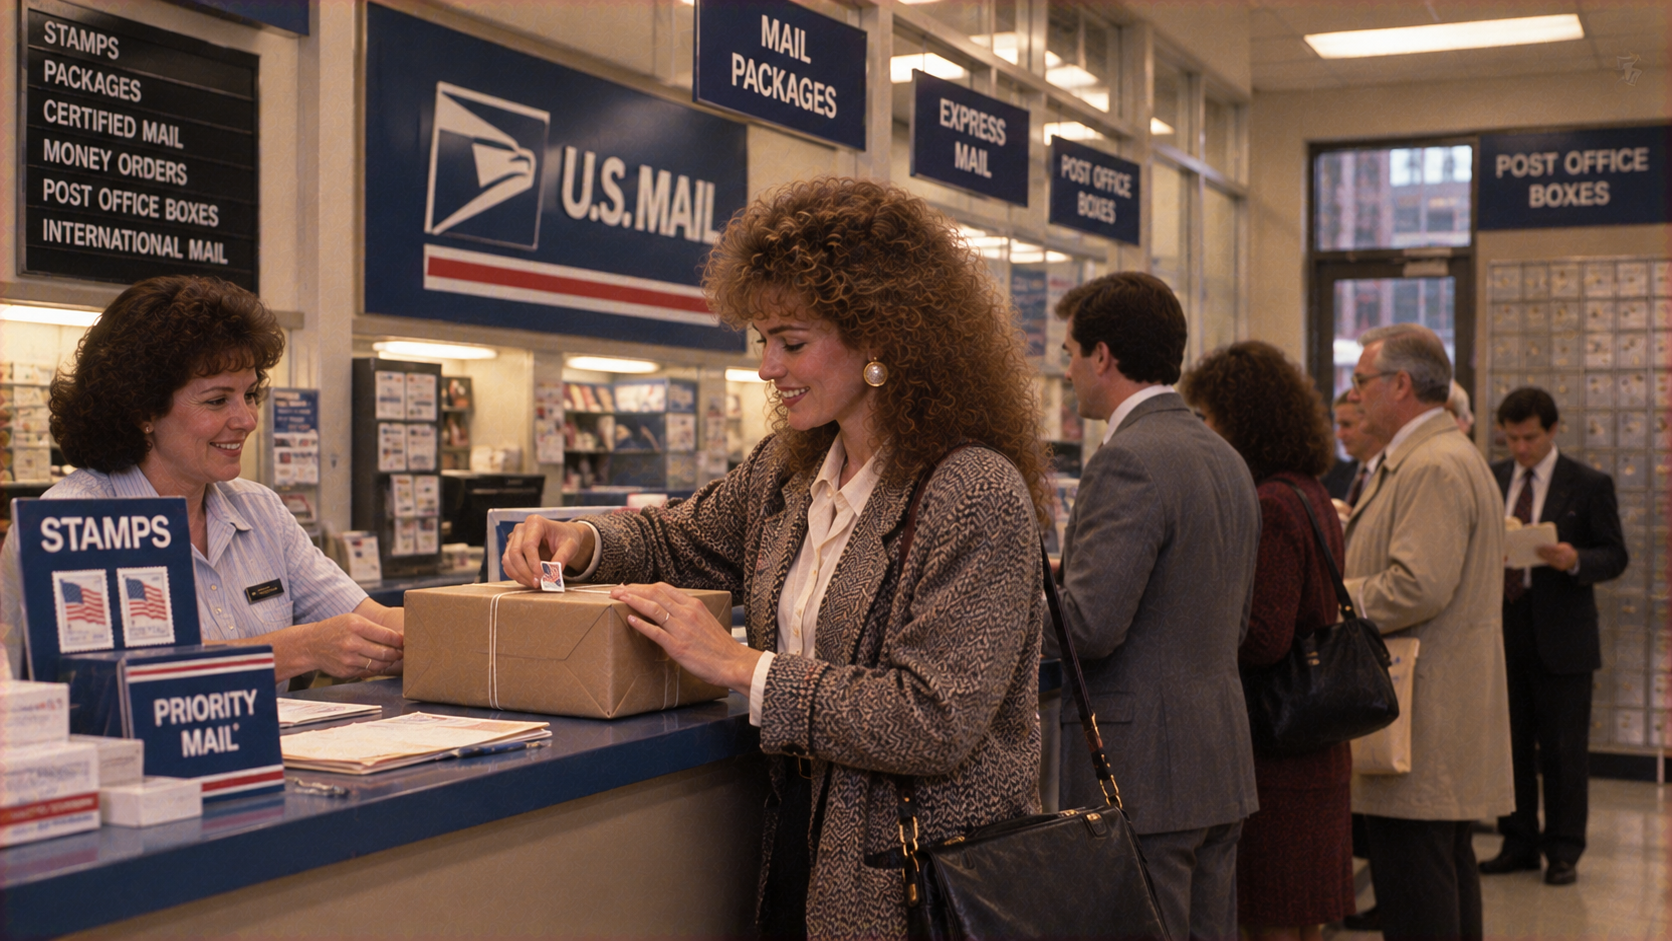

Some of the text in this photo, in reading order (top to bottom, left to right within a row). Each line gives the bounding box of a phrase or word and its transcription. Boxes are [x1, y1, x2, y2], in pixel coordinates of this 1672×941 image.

[43, 20, 119, 60] STAMPS
[761, 14, 811, 64] MAIL
[43, 59, 142, 102] PACKAGES
[731, 52, 837, 119] PACKAGES
[43, 99, 184, 149] CERTIFIED MAIL
[939, 98, 1007, 147] EXPRESS
[43, 138, 188, 186] MONEY ORDERS
[954, 141, 992, 179] MAIL
[1060, 154, 1133, 199] POST OFFICE
[1495, 147, 1650, 179] POST OFFICE
[43, 178, 219, 228] POST OFFICE BOXES
[561, 145, 721, 244] U.S. MAIL
[1077, 191, 1117, 225] BOXES
[1528, 181, 1611, 209] BOXES
[43, 218, 229, 265] INTERNATIONAL MAIL
[40, 515, 172, 553] STAMPS
[153, 688, 258, 728] PRIORITY
